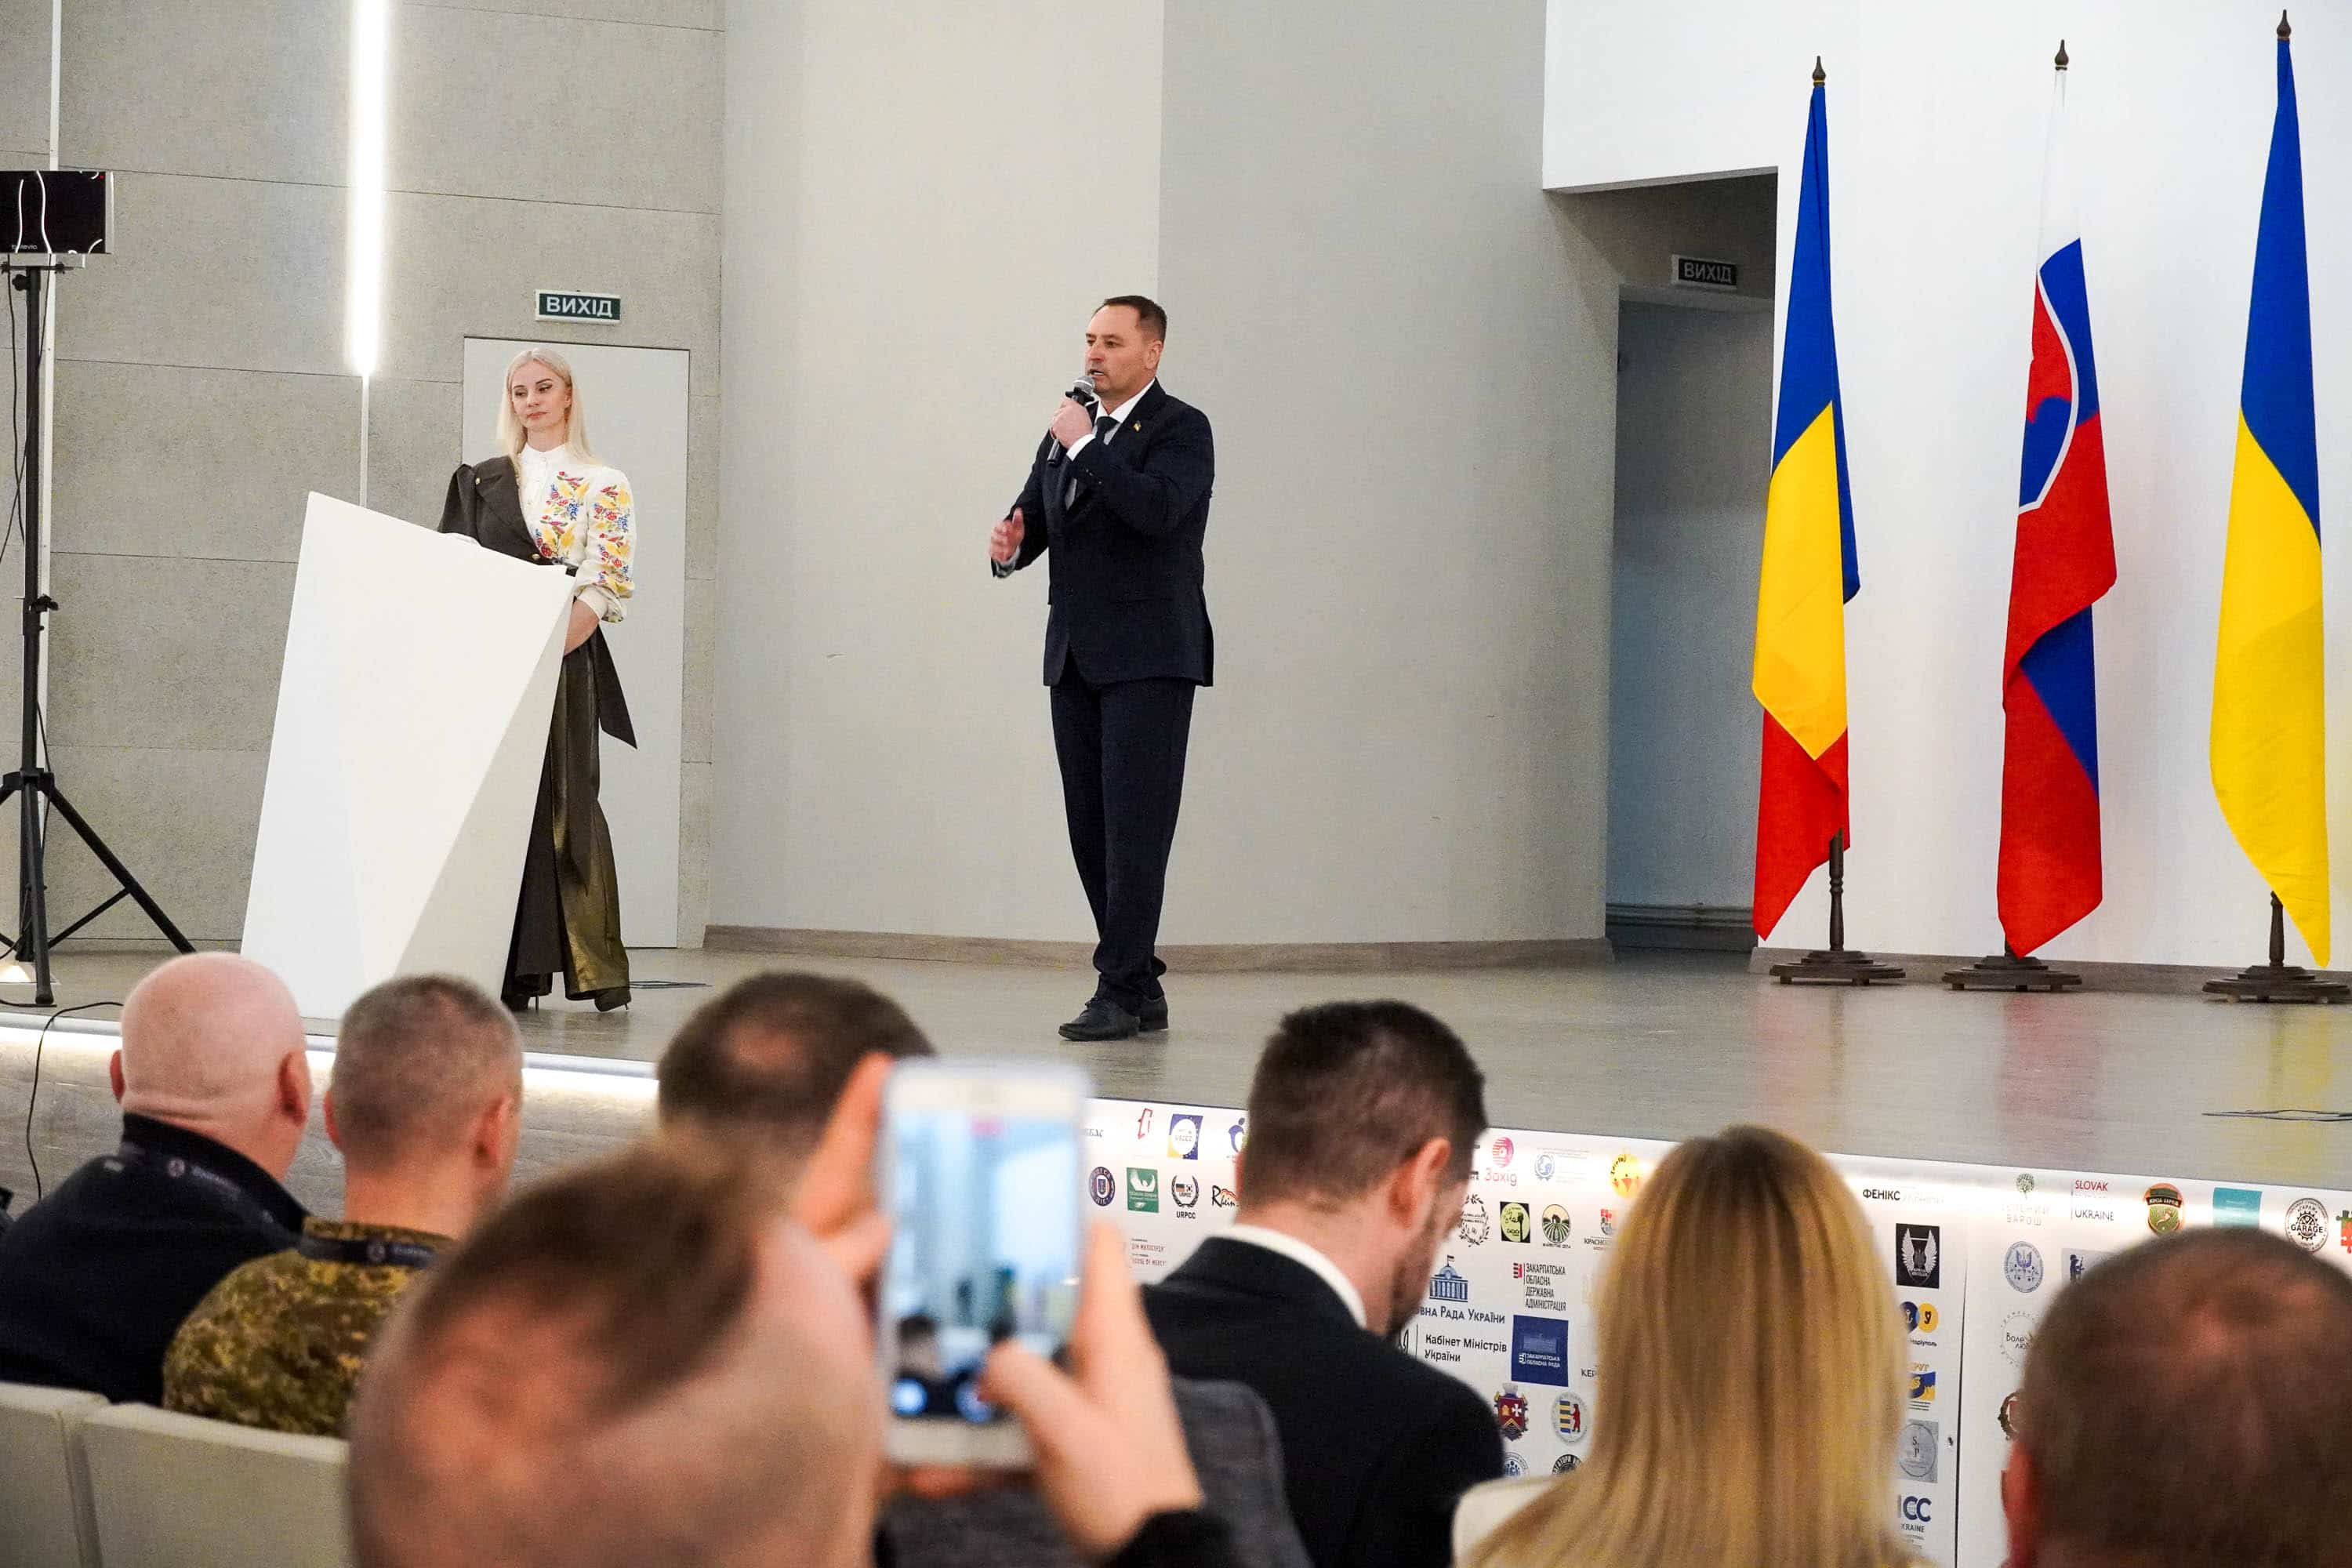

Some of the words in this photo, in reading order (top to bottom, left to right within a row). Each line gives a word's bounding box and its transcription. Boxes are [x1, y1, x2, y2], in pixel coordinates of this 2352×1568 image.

[1684, 262, 1732, 283] ВИХІД
[546, 296, 612, 318] ВИХІД
[2075, 1180, 2108, 1192] SLOVAK
[1863, 1189, 1900, 1201] ФЕНІКС
[2074, 1209, 2114, 1221] UKRAINE
[2291, 1224, 2324, 1233] GARAGE
[1526, 1263, 1566, 1275] ЗАКАРПАТСЬКА
[1526, 1275, 1551, 1286] ОБЛАСНА
[1526, 1287, 1555, 1298] ДЕРЖАВНА
[1526, 1298, 1566, 1311] АДМІНІСТРАЦІЯ
[1425, 1334, 1461, 1346] Кабінет
[1463, 1338, 1508, 1352] Міністрів
[1425, 1348, 1461, 1362] України
[1900, 1523, 1926, 1533] KRAINE
